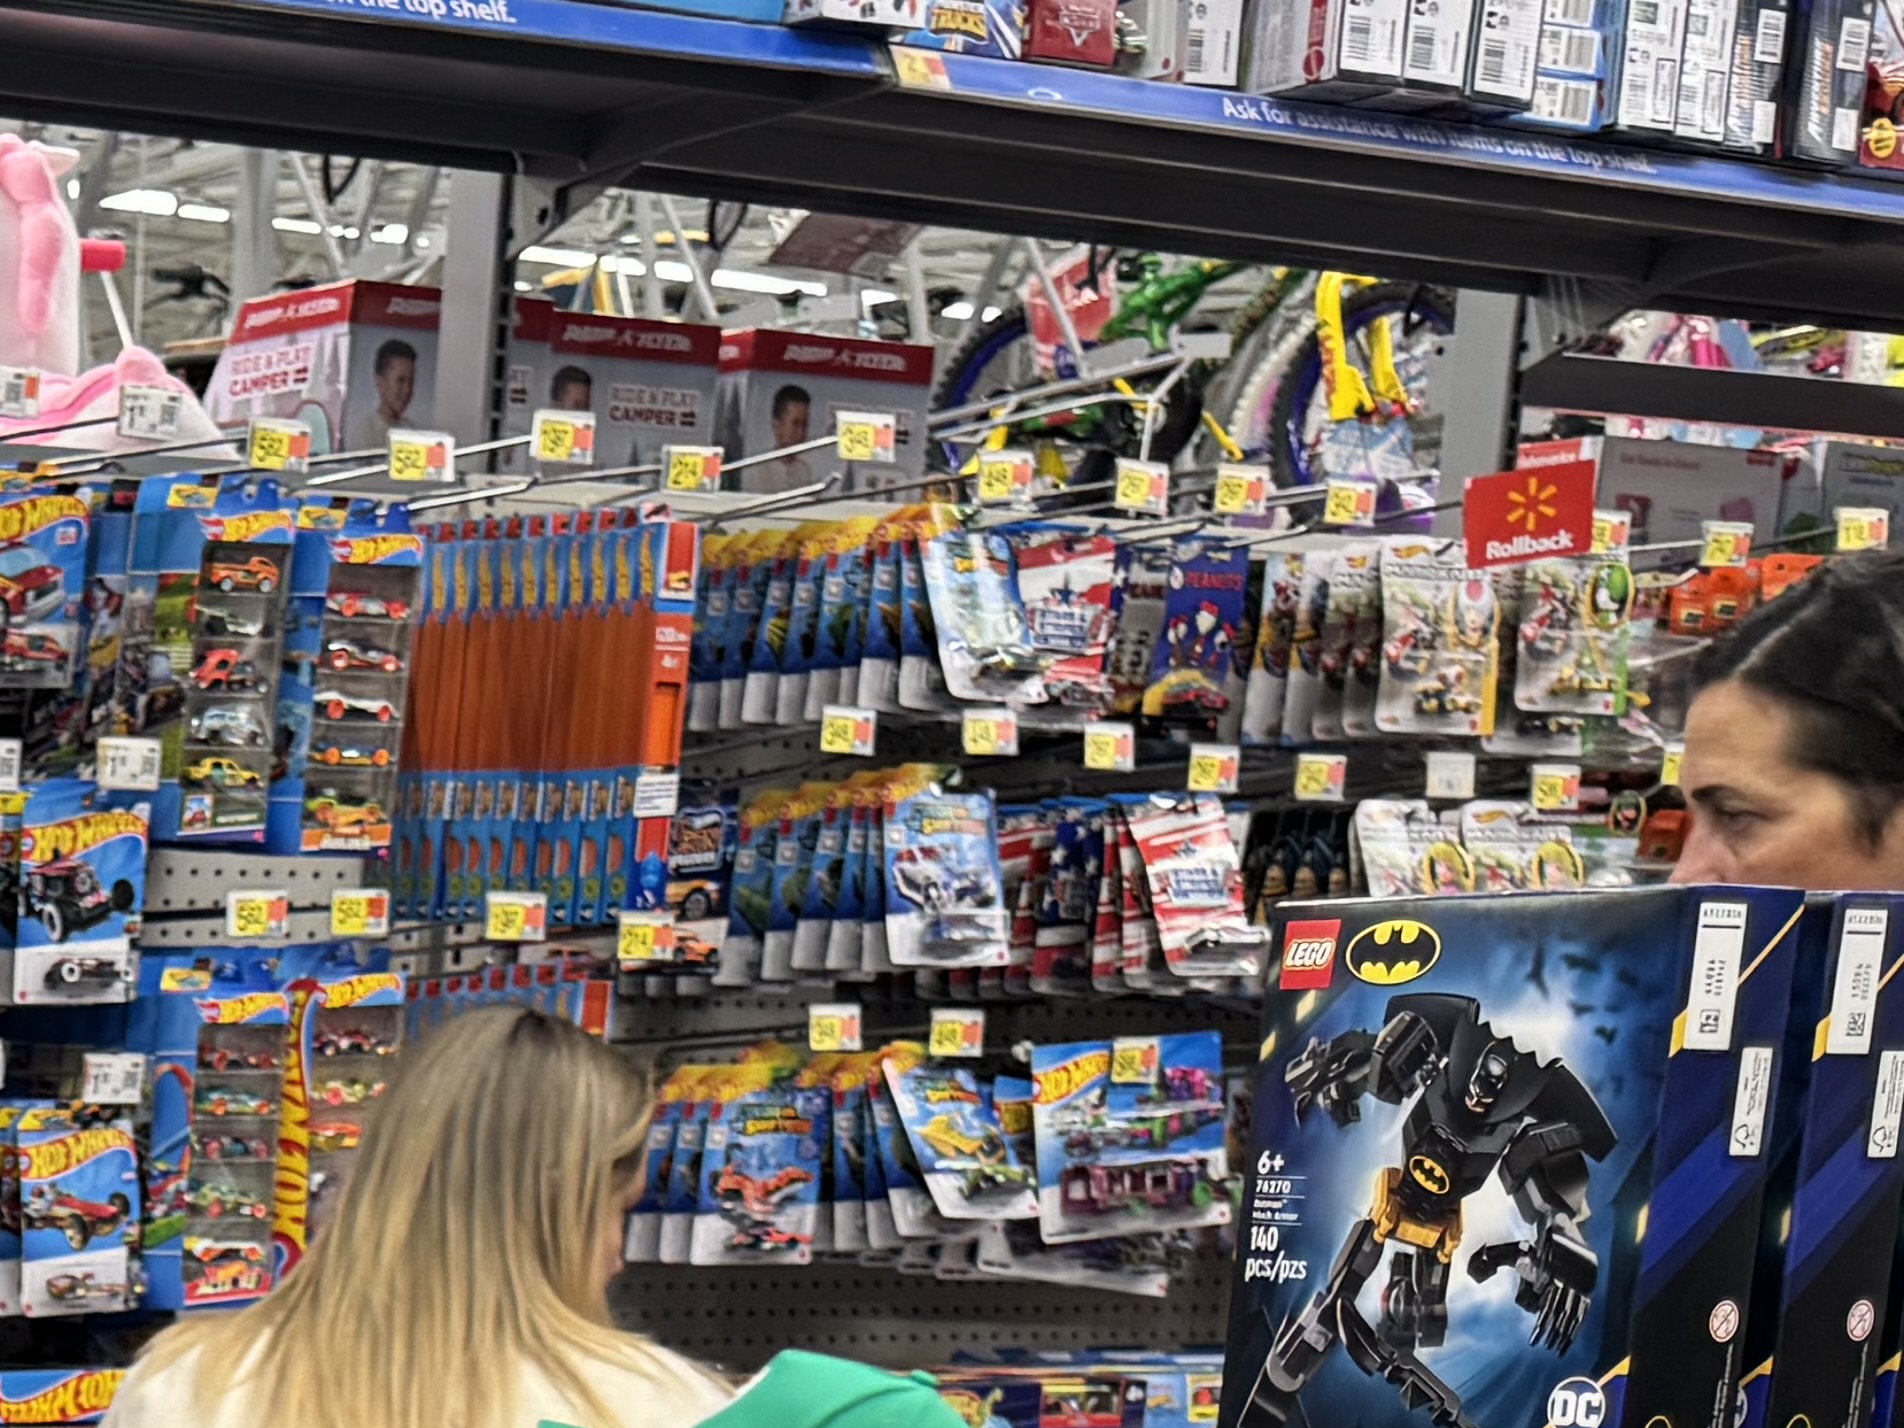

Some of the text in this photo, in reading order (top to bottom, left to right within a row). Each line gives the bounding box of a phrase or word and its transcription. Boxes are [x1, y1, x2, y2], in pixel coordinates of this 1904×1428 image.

[1224, 97, 1257, 122] Ask
[1260, 101, 1293, 125] for
[1298, 108, 1396, 140] assistance
[1399, 121, 1447, 145] with
[1449, 127, 1504, 154] items
[1508, 139, 1530, 156] on
[1533, 140, 1567, 162] the
[1570, 147, 1598, 171] top
[231, 367, 290, 396] CAMPER
[609, 406, 676, 428] CAMPER
[1485, 530, 1575, 560] Rollback
[1185, 571, 1243, 591] PEANUTS
[33, 826, 75, 861] HOT
[1284, 939, 1335, 968] LEGO
[31, 1136, 73, 1176] HOT
[1257, 1150, 1284, 1173] 6+
[1255, 1179, 1291, 1195] 76270
[1249, 1226, 1279, 1252] 140
[1245, 1255, 1307, 1282] pcs/pzs
[1554, 1389, 1601, 1428] DC
